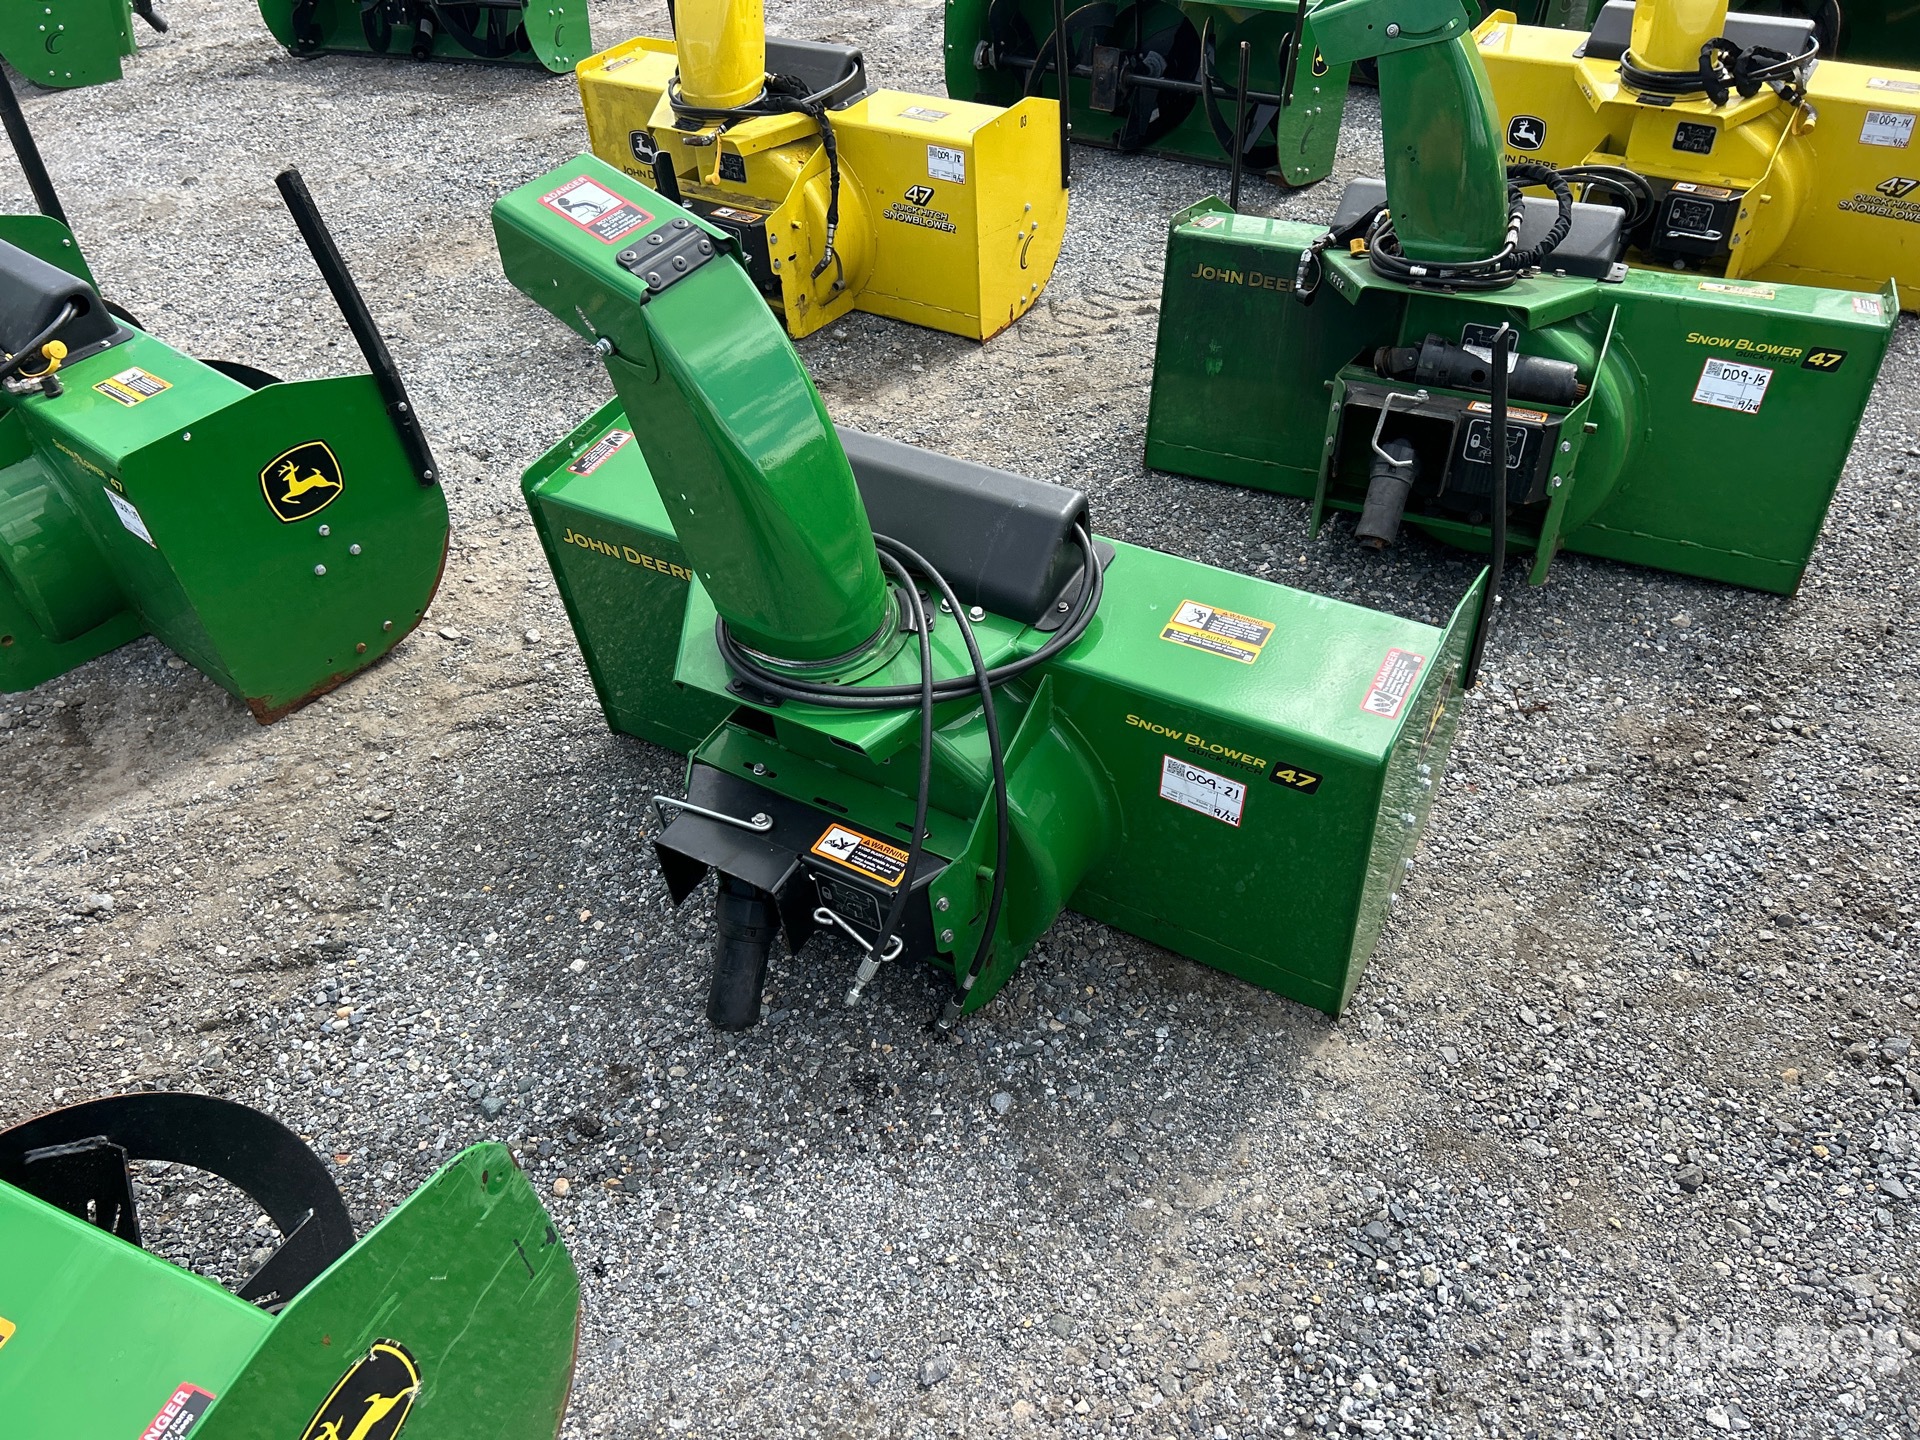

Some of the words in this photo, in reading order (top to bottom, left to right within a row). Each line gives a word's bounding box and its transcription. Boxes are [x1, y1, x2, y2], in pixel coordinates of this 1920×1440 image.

[1879, 114, 1912, 127] 009-14
[549, 176, 588, 199] DANGER
[905, 185, 934, 206] 47
[1876, 177, 1917, 198] 47
[891, 202, 919, 215] QUICK
[920, 208, 948, 221] HITCH
[1837, 200, 1920, 223] SNOWBLOWE
[1853, 193, 1889, 208] QUICK
[1890, 198, 1920, 213] HITC
[883, 210, 956, 233] SNOWBLOWER
[1192, 263, 1244, 285] JOHN
[1686, 332, 1735, 348] SNOW
[1735, 339, 1803, 358] BLOWER
[1807, 352, 1842, 368] 47
[1721, 367, 1766, 386] 009-15
[563, 528, 620, 559] JOHN
[1200, 632, 1233, 646] CAUTION
[1375, 651, 1400, 683] DANGER
[1125, 714, 1182, 740] SNOW
[1184, 733, 1267, 769] BLOWER
[1276, 769, 1317, 787] 47
[1187, 747, 1224, 762] QUICK
[1225, 758, 1263, 776] HITCH
[1185, 770, 1240, 800] 009-21
[144, 1390, 191, 1440] NGER
[169, 1410, 188, 1431] from
